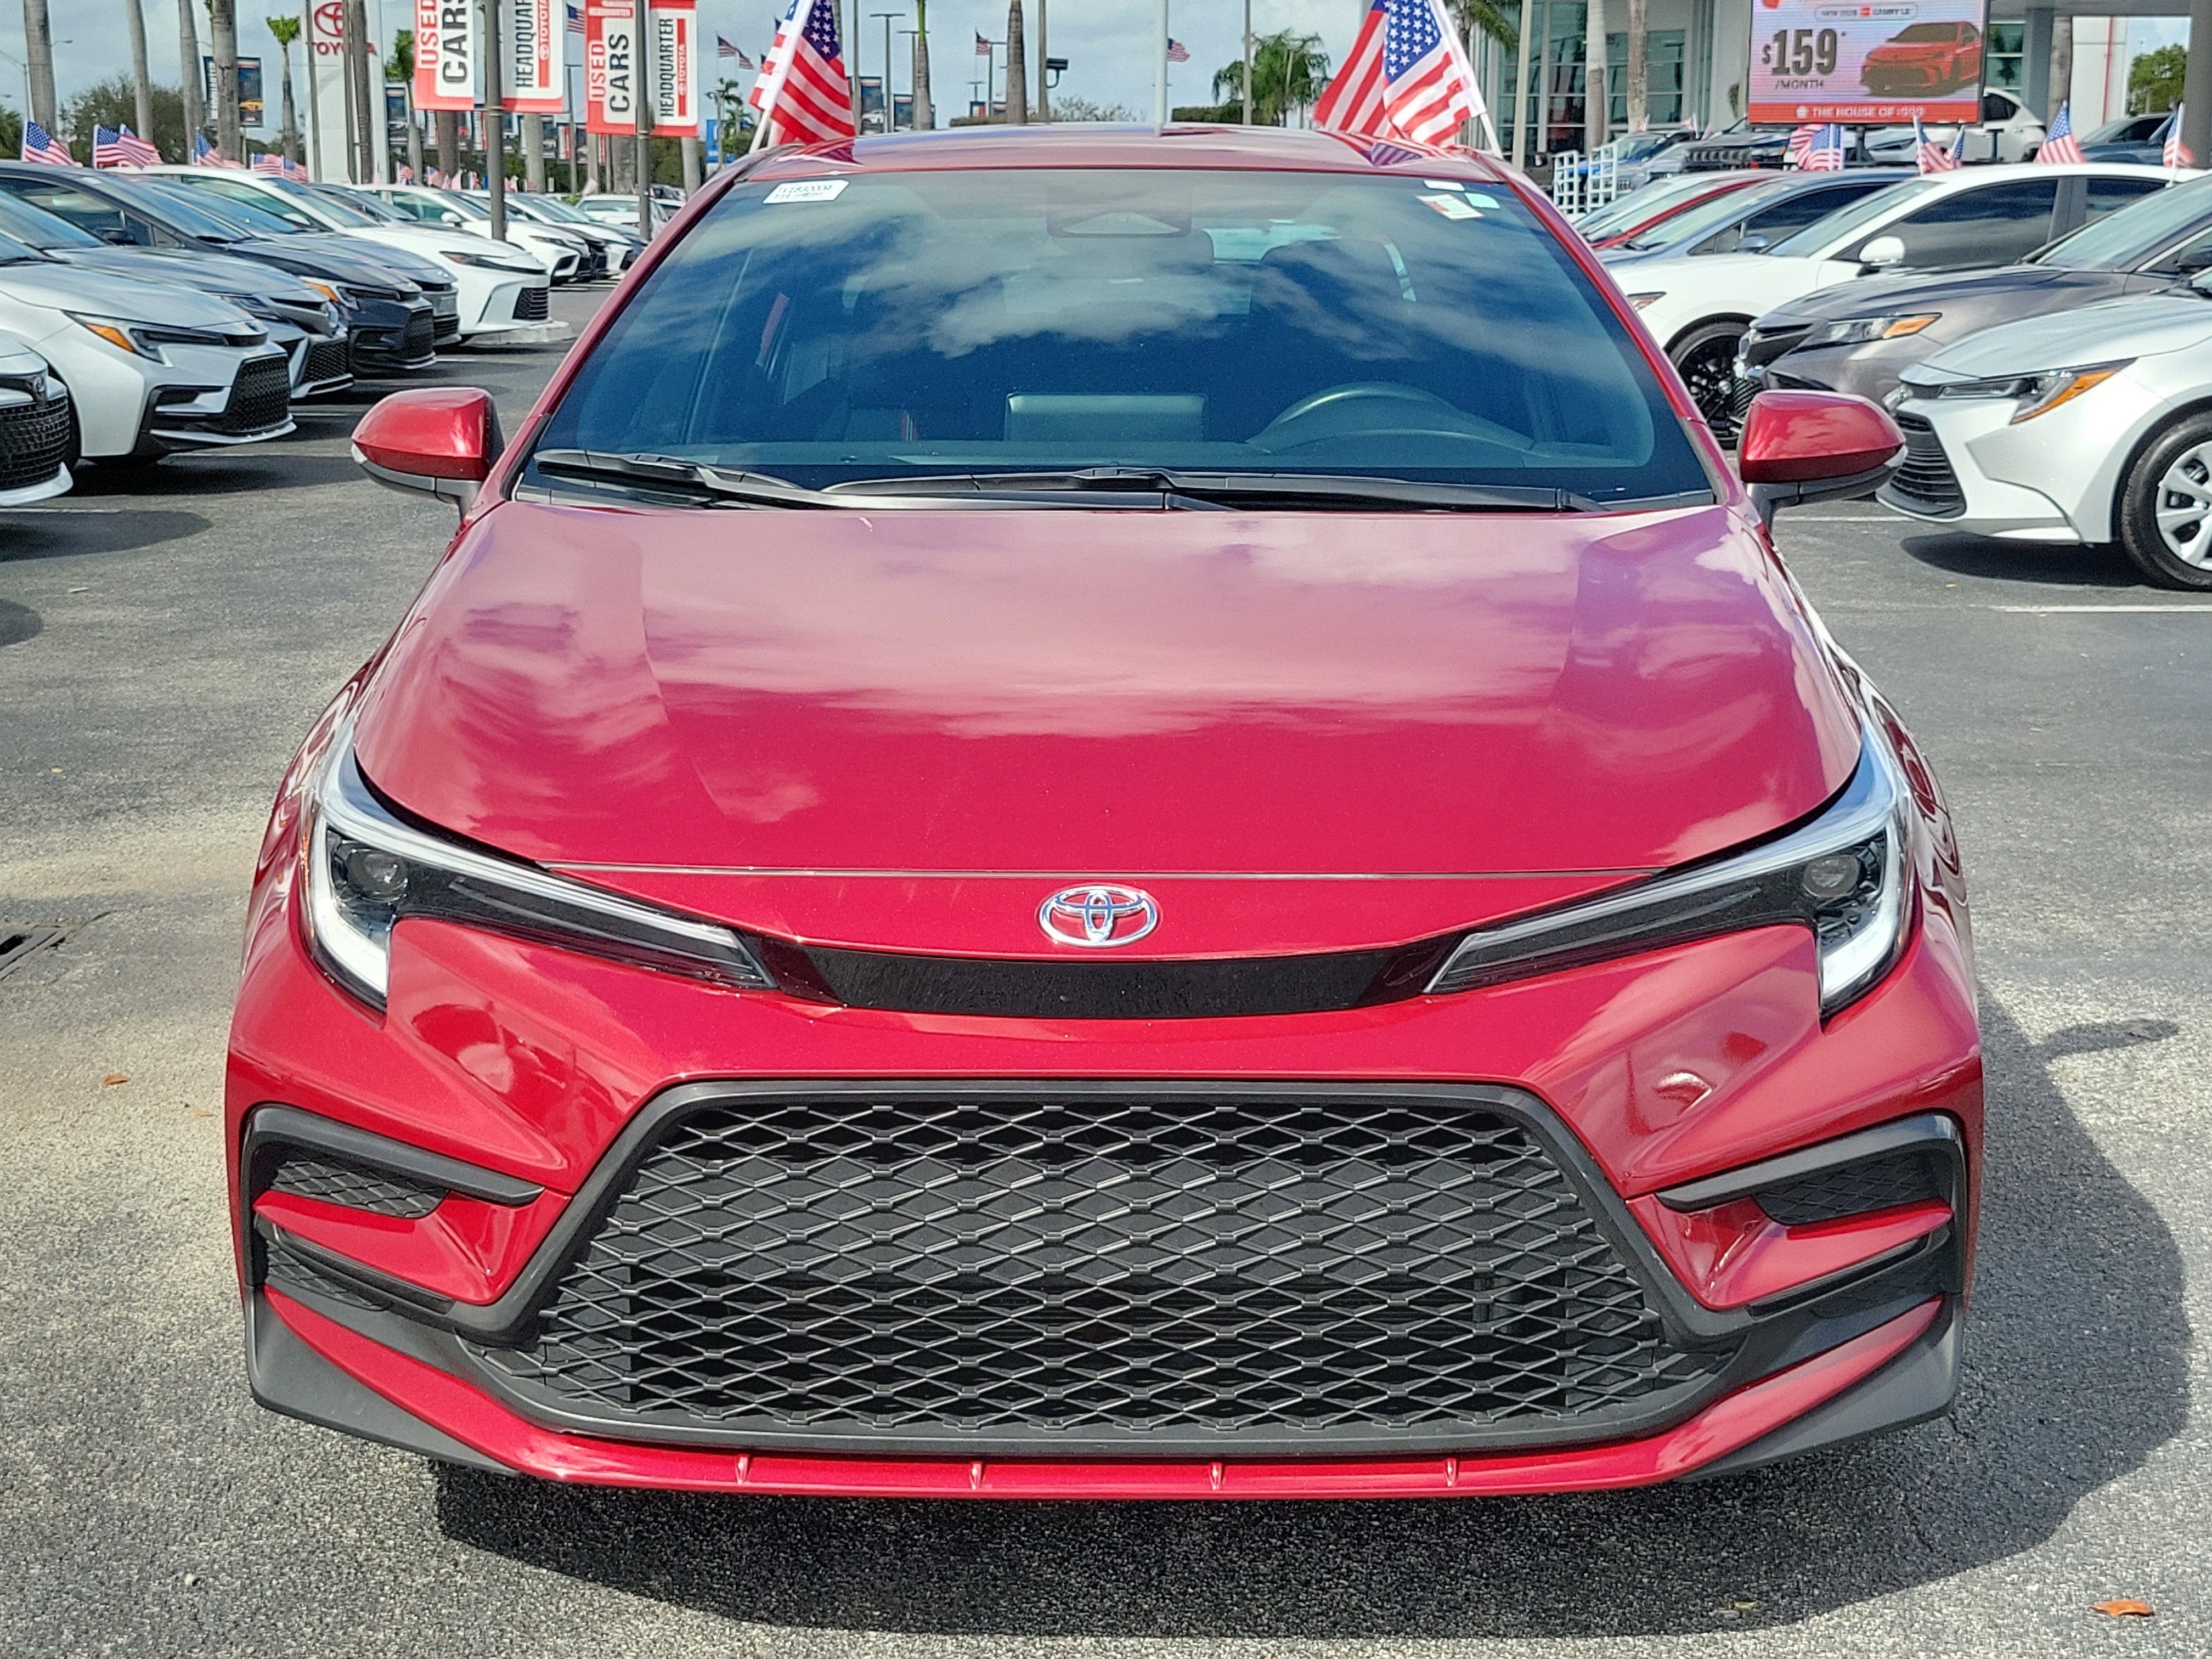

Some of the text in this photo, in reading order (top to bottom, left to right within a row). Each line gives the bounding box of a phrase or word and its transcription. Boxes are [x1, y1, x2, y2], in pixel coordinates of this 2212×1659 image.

[421, 0, 438, 65] USED
[442, 0, 467, 83] CAR
[591, 44, 606, 97] USED
[609, 34, 629, 112] CARS
[659, 18, 675, 117] HEADQUARTER
[1776, 80, 1823, 89] /MONTH
[1813, 105, 1833, 117] THE
[1836, 105, 1875, 117] HOUSE
[1878, 105, 1894, 117] OF
